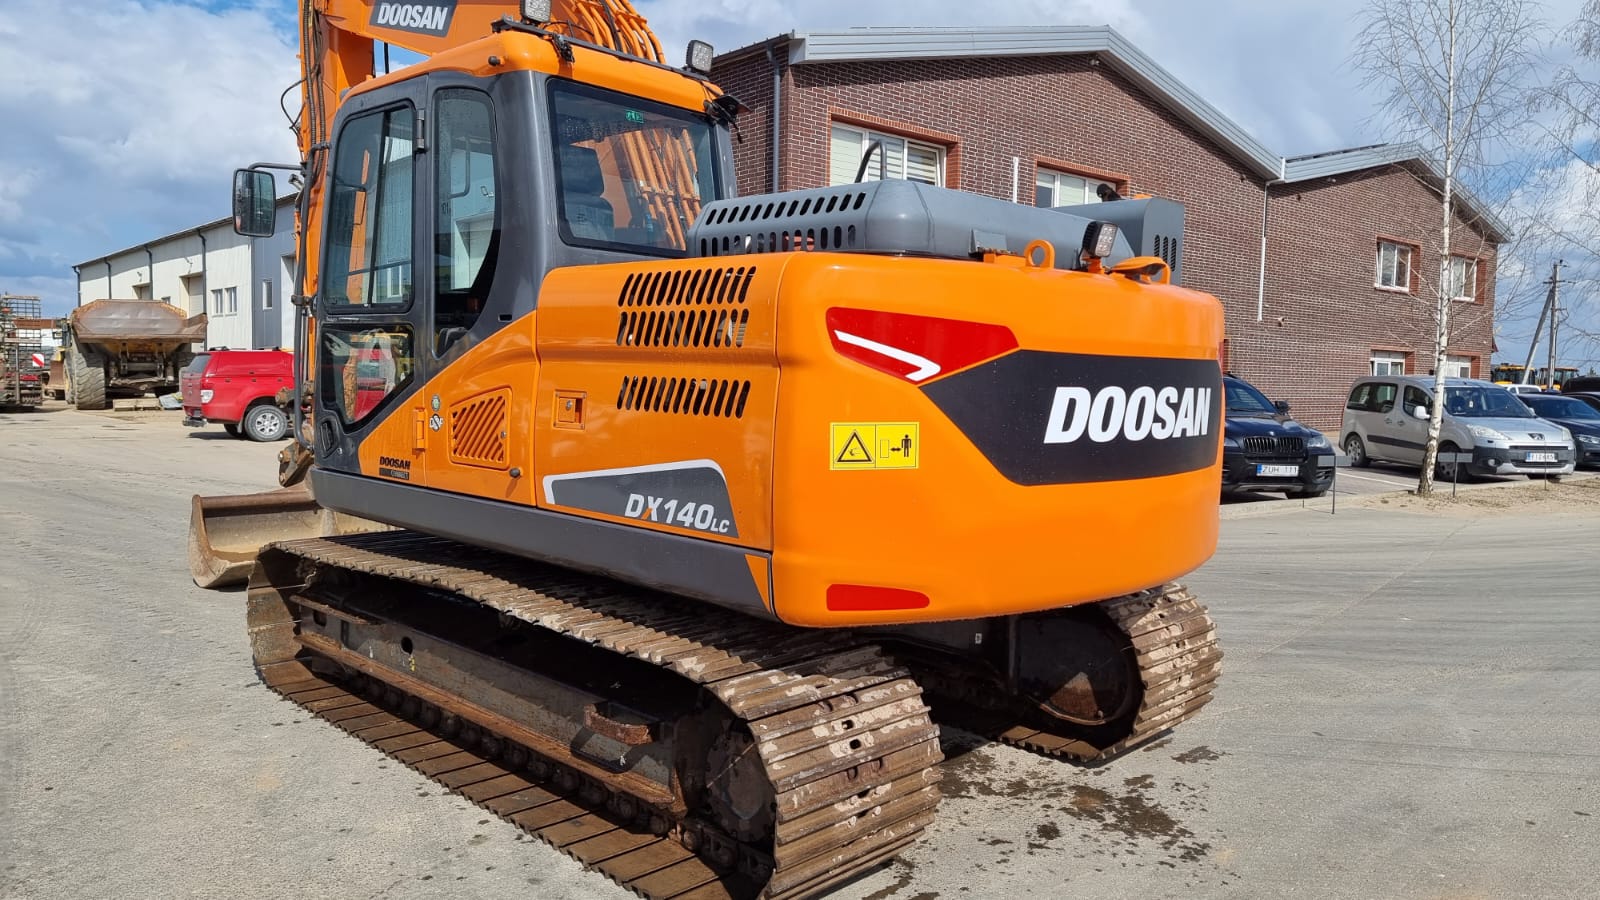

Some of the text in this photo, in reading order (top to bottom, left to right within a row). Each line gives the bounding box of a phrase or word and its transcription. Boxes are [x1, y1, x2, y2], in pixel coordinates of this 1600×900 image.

[377, 2, 448, 30] DOOSAN
[1043, 385, 1212, 444] DOOSAN
[379, 456, 411, 470] DOOSAN
